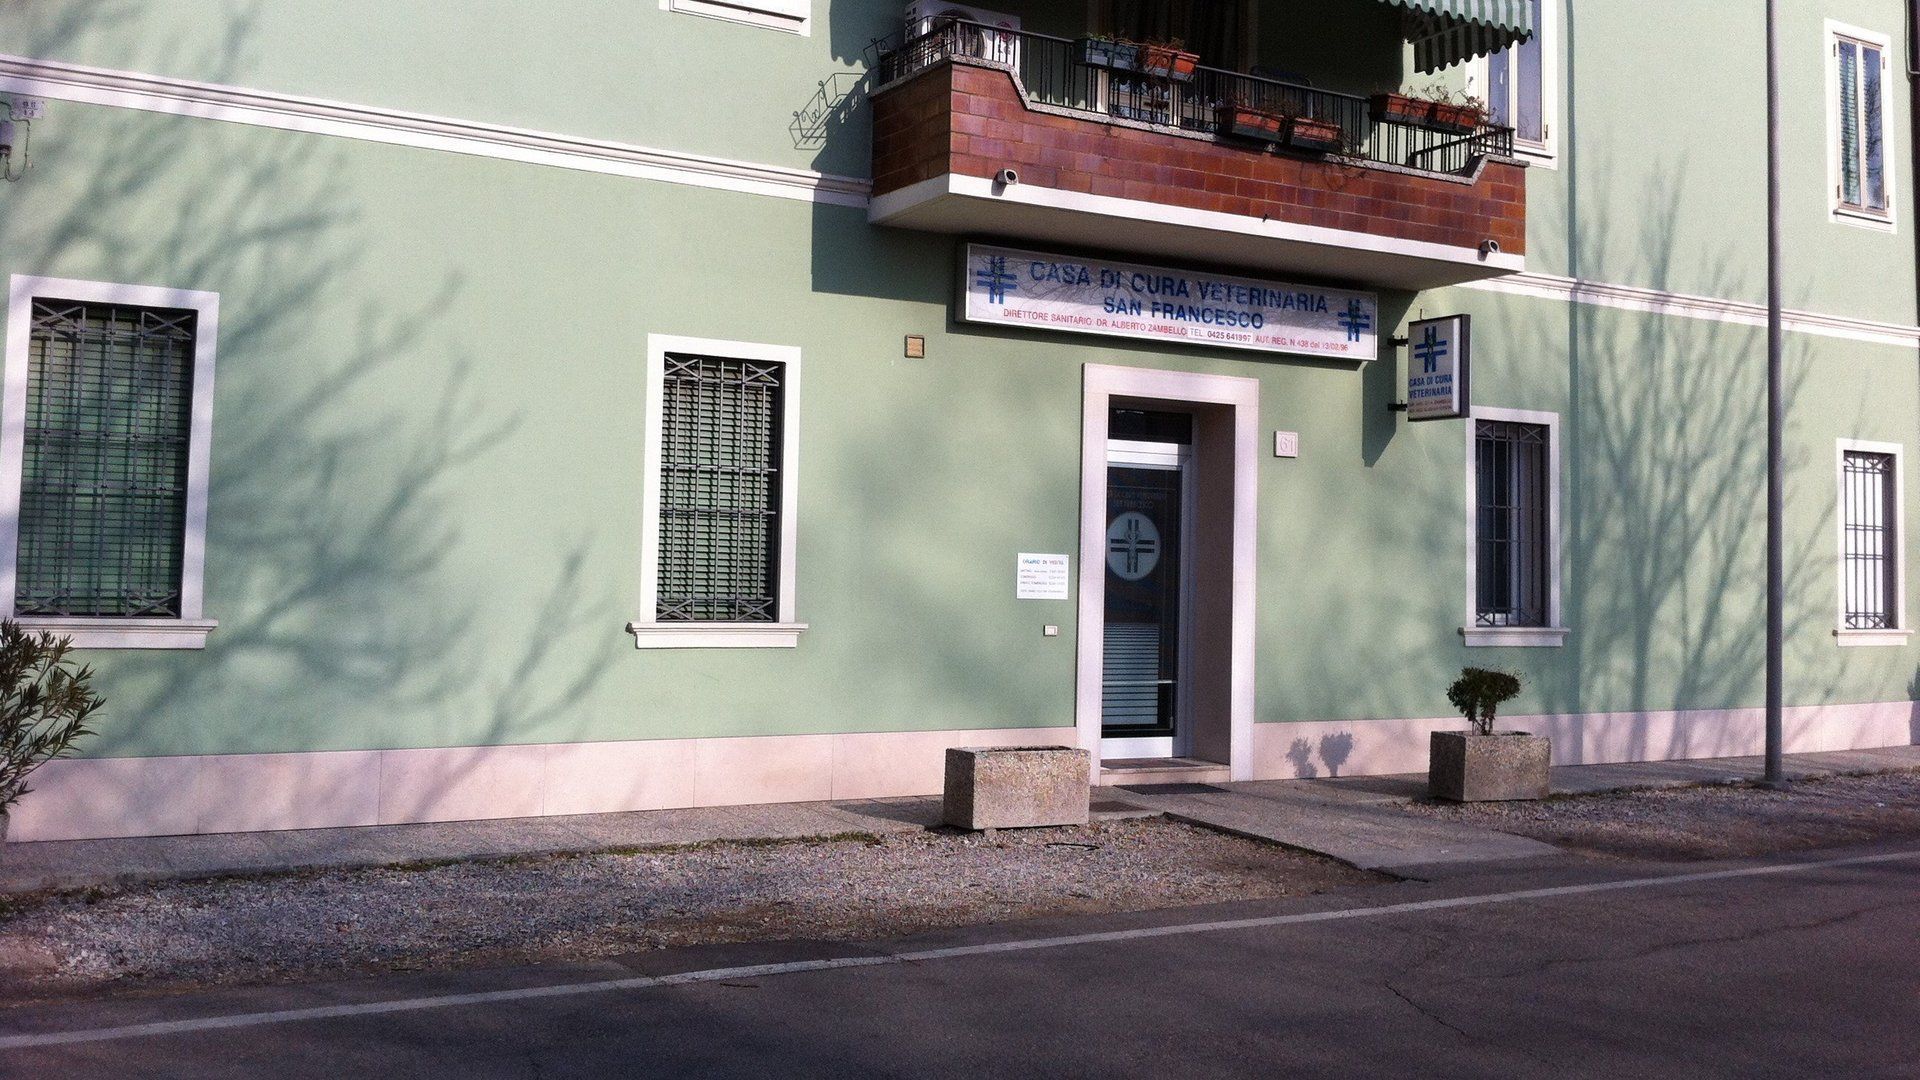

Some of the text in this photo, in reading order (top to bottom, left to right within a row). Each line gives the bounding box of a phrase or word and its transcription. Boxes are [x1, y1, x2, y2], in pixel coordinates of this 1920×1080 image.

[1029, 261, 1329, 314] CASA DI CURA VETERINARIA
[1003, 308, 1049, 321] DIRETTORE
[1111, 320, 1146, 331] ALBERTO
[1207, 330, 1225, 339] 0425
[1104, 296, 1264, 330] SAN FRANCESCO
[1409, 377, 1425, 387] CASA
[1435, 374, 1452, 384] CURA
[1409, 386, 1452, 399] VETERINARIA
